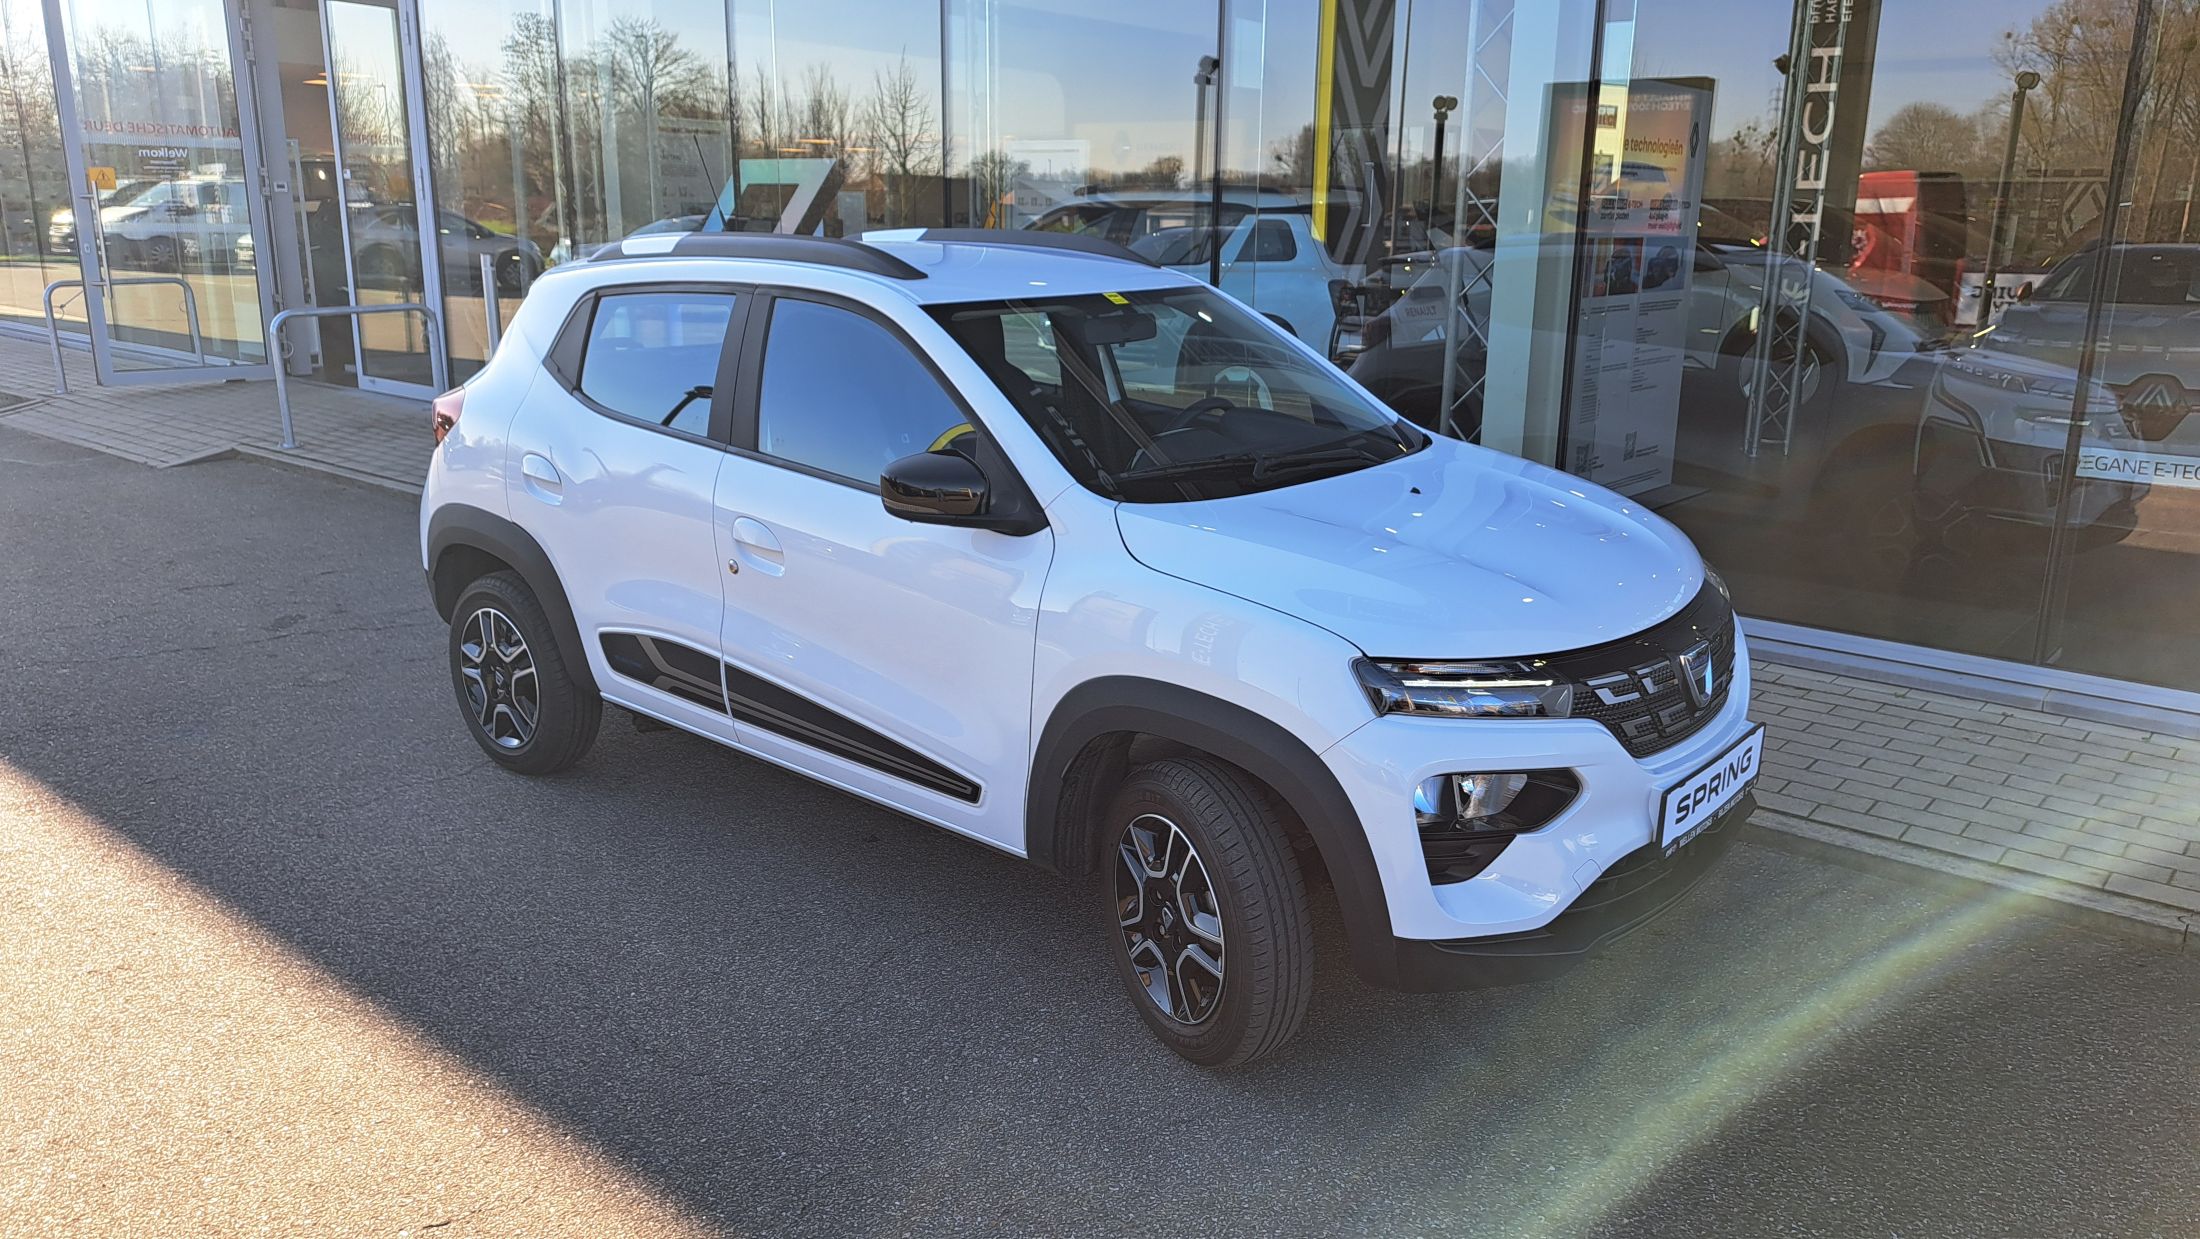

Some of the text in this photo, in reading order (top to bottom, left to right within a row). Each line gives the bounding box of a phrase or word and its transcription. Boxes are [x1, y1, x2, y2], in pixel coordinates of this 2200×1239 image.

[1405, 305, 1437, 317] RENAULT
[2079, 454, 2151, 476] EGANE
[1675, 745, 1753, 825] SPRING
